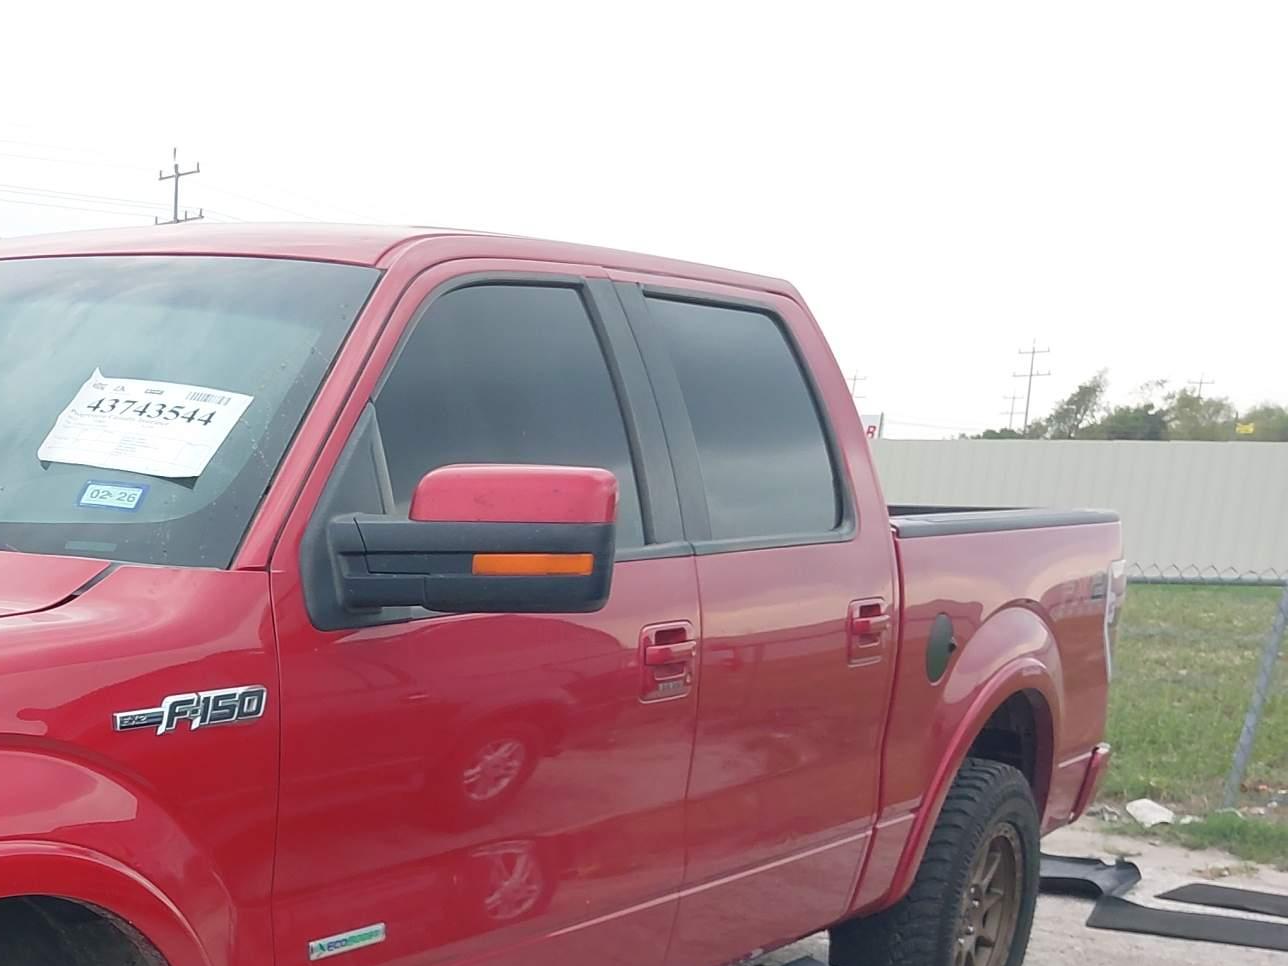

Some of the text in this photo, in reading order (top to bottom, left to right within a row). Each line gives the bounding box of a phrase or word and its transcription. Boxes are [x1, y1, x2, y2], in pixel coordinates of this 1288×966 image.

[86, 397, 217, 427] 43743544
[89, 488, 138, 503] 02 26
